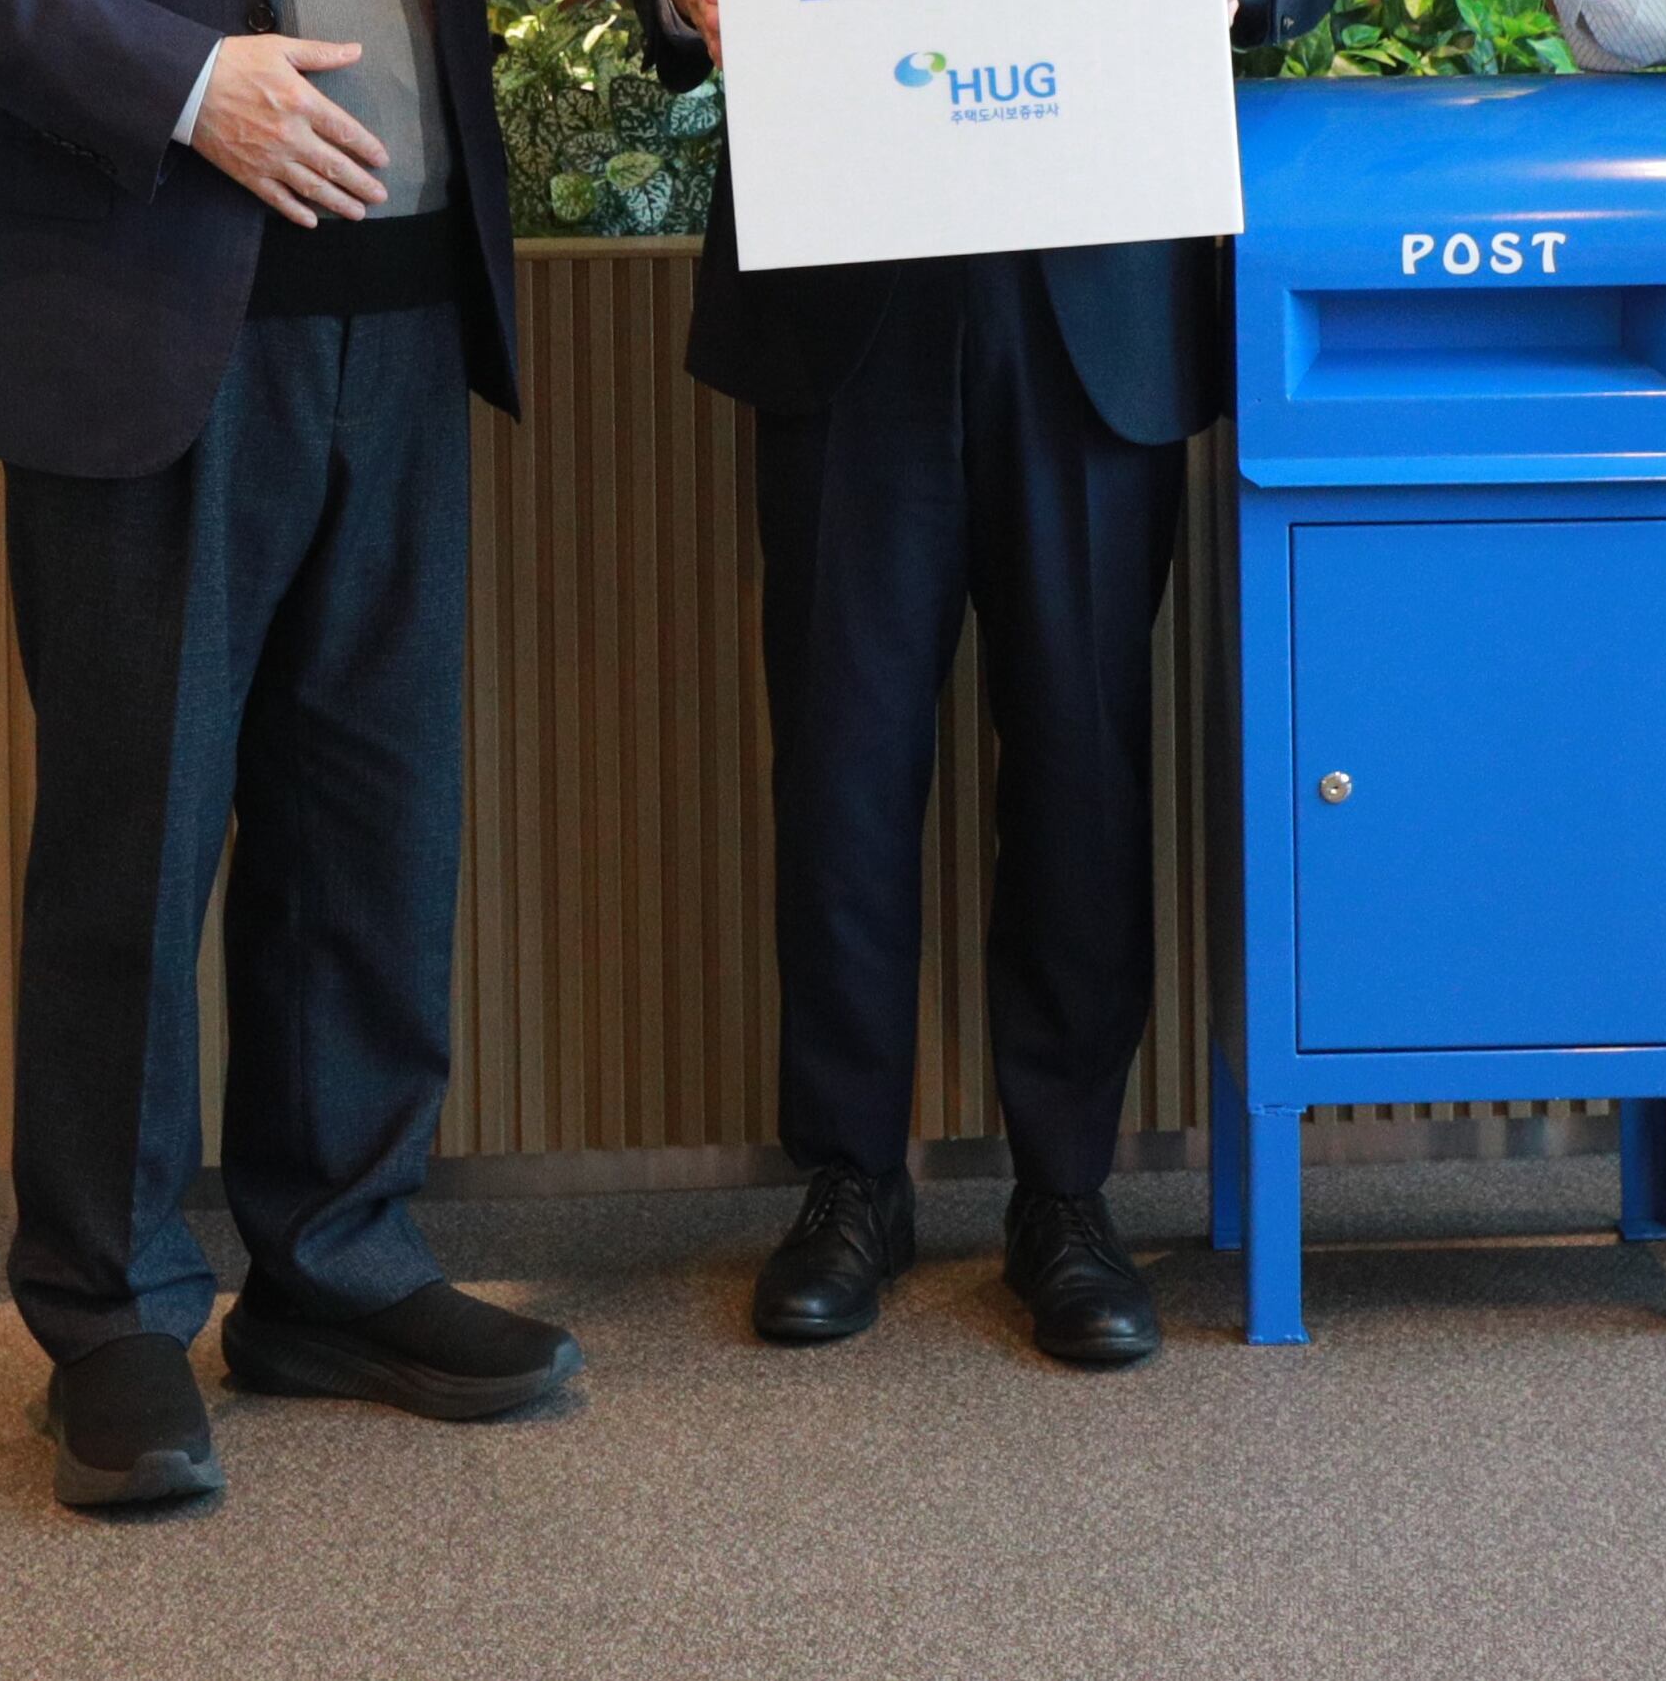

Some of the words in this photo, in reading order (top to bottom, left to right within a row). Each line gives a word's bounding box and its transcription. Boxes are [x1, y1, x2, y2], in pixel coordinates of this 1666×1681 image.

[946, 62, 1057, 105] HUG
[950, 103, 1059, 126] 주택도시보증공사
[1401, 232, 1566, 275] POST
